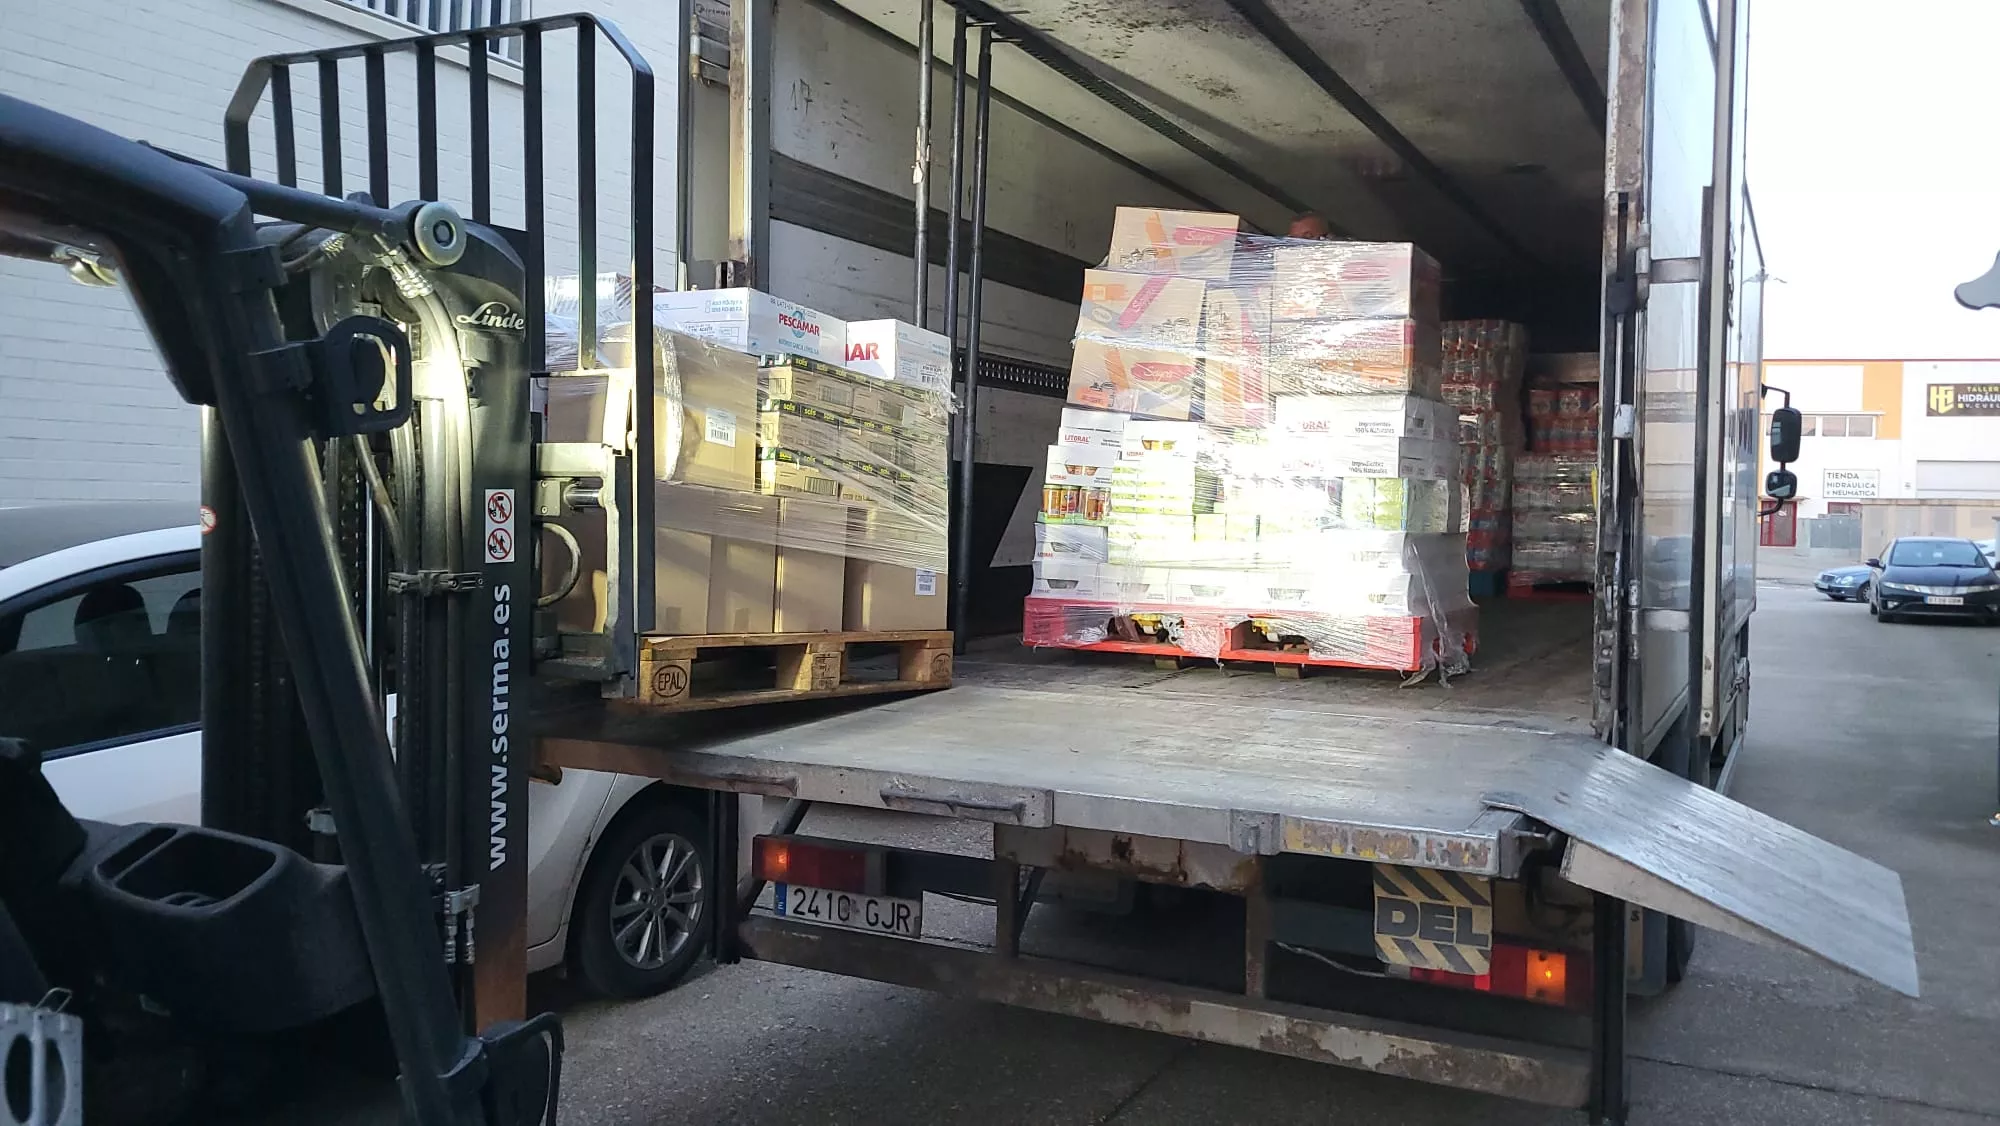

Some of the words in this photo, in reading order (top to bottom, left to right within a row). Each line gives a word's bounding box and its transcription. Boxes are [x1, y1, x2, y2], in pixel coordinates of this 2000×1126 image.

[456, 301, 525, 330] Linde
[778, 313, 820, 337] PESCAMAR
[1827, 472, 1859, 480] TIENDA
[657, 671, 683, 691] EPAL
[490, 583, 511, 872] www.serma.es
[866, 899, 910, 933] GJR
[1376, 896, 1490, 948] DEL
